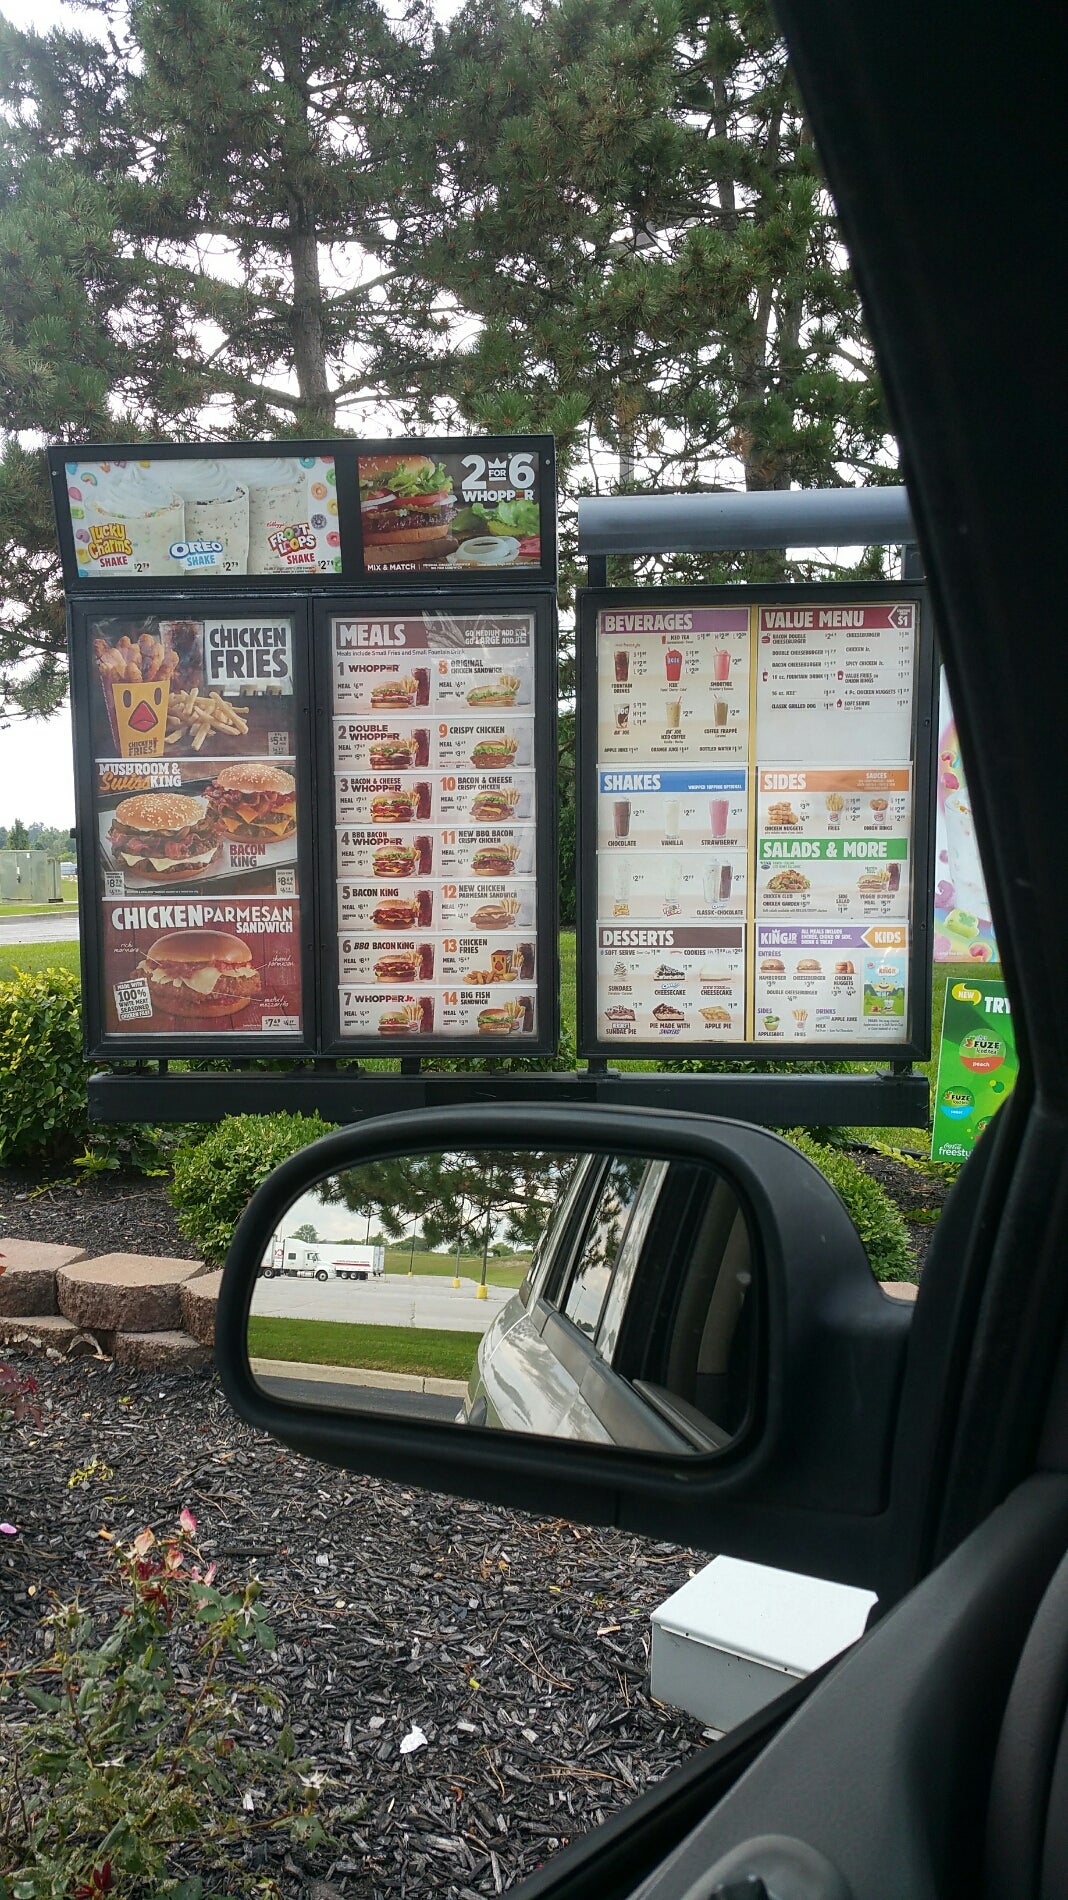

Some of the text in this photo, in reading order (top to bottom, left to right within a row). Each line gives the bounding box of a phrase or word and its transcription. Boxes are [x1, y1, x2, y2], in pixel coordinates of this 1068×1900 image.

[461, 454, 486, 490] 2
[489, 469, 507, 478] FOR
[88, 539, 133, 560] Charms
[169, 541, 223, 559] OREO
[100, 556, 128, 567] SHAKE
[187, 555, 216, 566] SHAKE
[287, 553, 316, 565] SHAKE
[605, 614, 693, 632] BEVERAGES
[765, 610, 864, 628] VALUE MENU
[898, 616, 908, 626] $1
[209, 627, 286, 648] CHICKEN
[340, 624, 406, 646] MEALS
[211, 649, 288, 679] FRIES
[337, 662, 399, 676] 1 WHOPPER
[338, 725, 346, 740] 2
[439, 724, 448, 738] 9
[99, 763, 180, 775] MUSHROOM &
[150, 776, 182, 788] KING
[340, 778, 348, 792] 3
[440, 777, 456, 791] 10
[604, 774, 661, 790] SHAKES
[764, 774, 806, 790] SIDES
[341, 832, 350, 846] 4
[441, 830, 456, 844] 11
[230, 844, 266, 856] BACON
[764, 842, 888, 858] SALADS & MORE
[230, 856, 258, 867] KING
[342, 886, 398, 900] 5 BACON KING
[441, 885, 456, 898] 12
[112, 905, 292, 930] CHICKEN PARMESAN
[236, 922, 292, 934] SANDWICH
[602, 930, 674, 946] DESSERTS
[760, 932, 788, 944] KING
[875, 932, 901, 943] KIDS
[342, 940, 352, 954] 6
[442, 938, 457, 952] 13
[118, 989, 147, 1002] 100%
[344, 992, 352, 1006] 7
[442, 992, 458, 1006] 14
[974, 1040, 1000, 1049] FUZE
[939, 1147, 974, 1160] freesty
